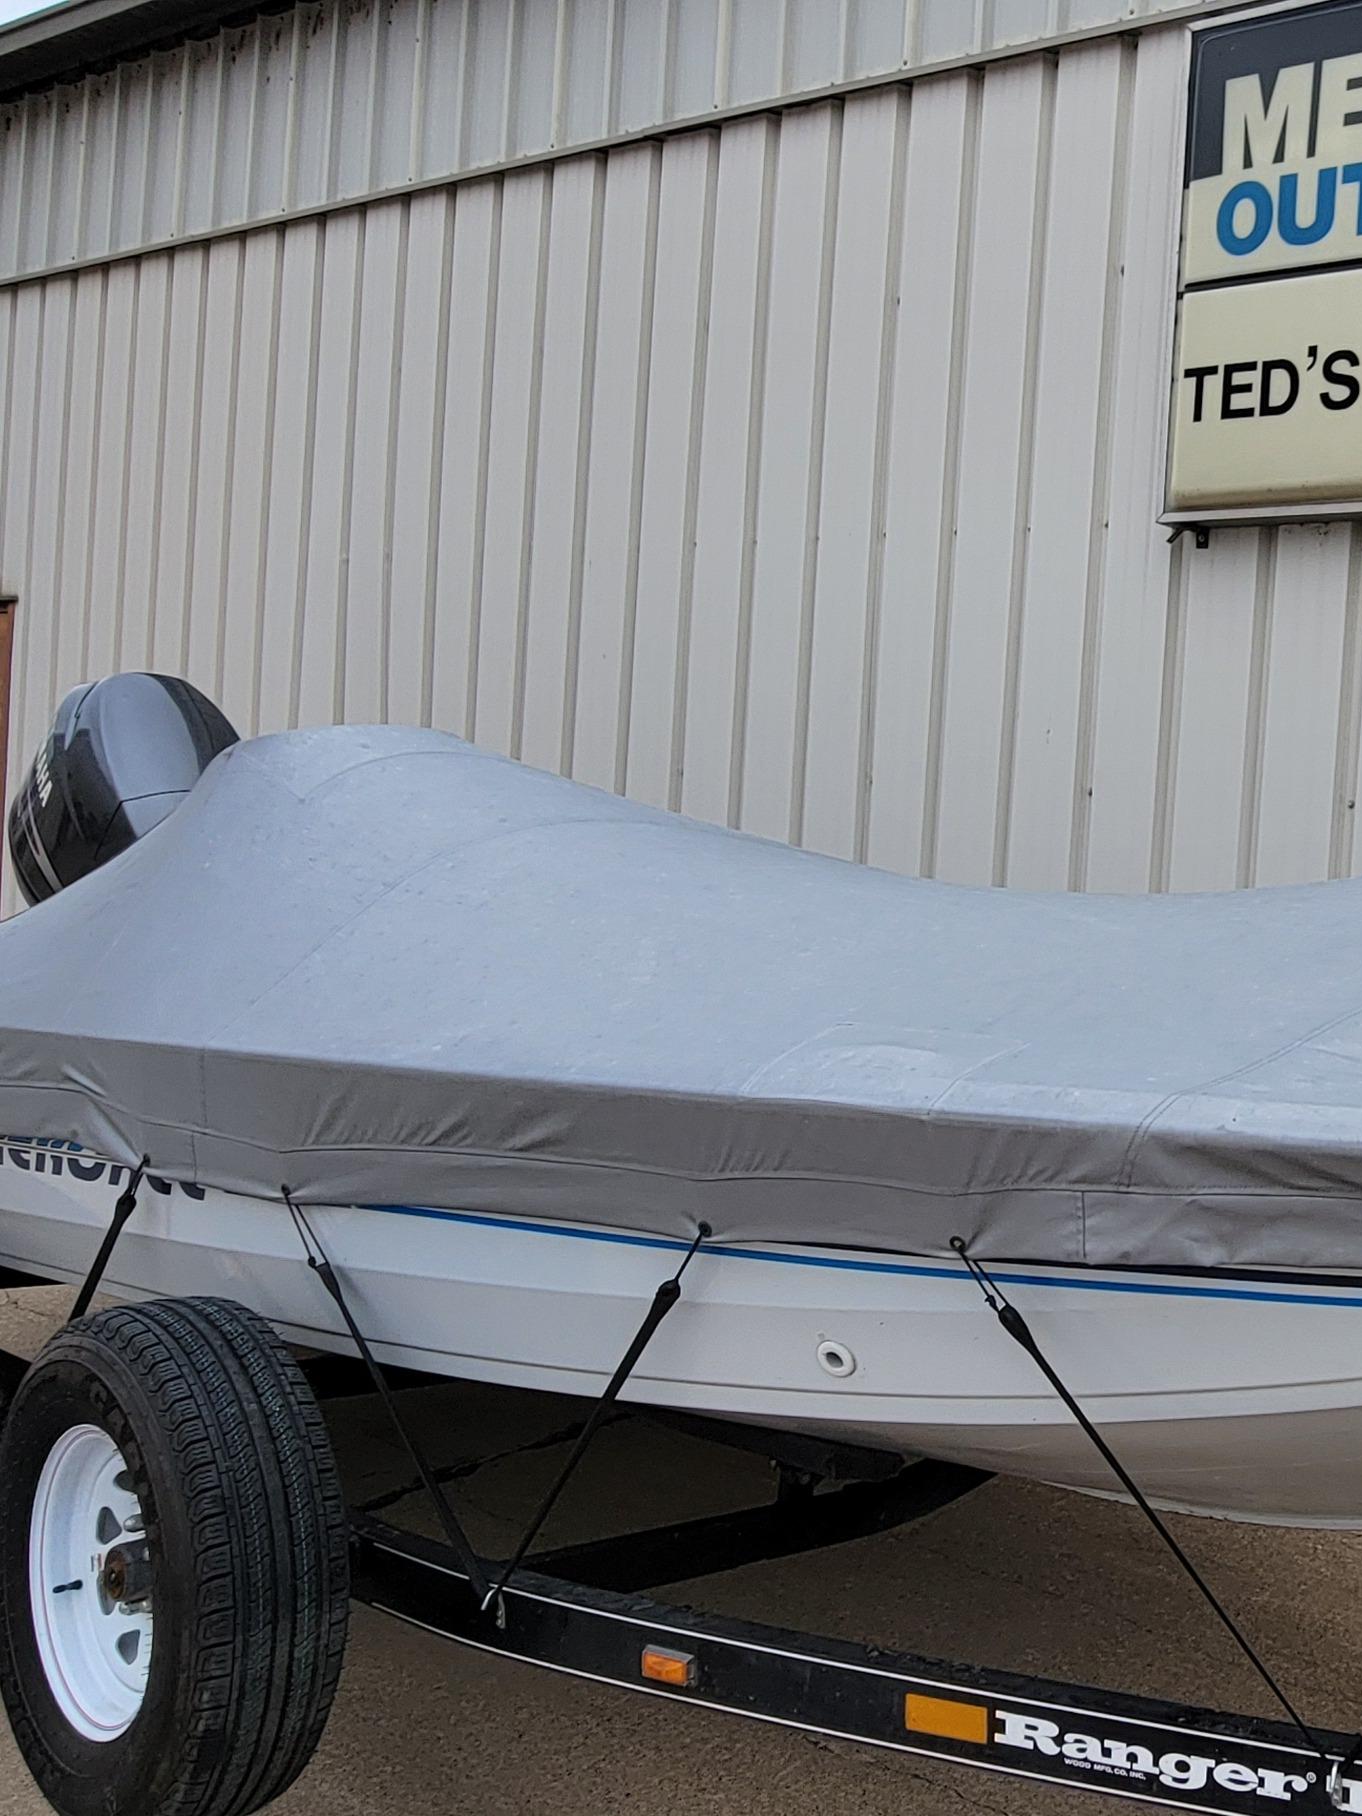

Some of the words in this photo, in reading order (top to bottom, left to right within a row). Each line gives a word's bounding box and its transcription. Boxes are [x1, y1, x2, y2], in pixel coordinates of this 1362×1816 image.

[1183, 345, 1361, 422] TED'S
[994, 1709, 1310, 1801] Ranger
[1063, 1757, 1091, 1769] WOOD
